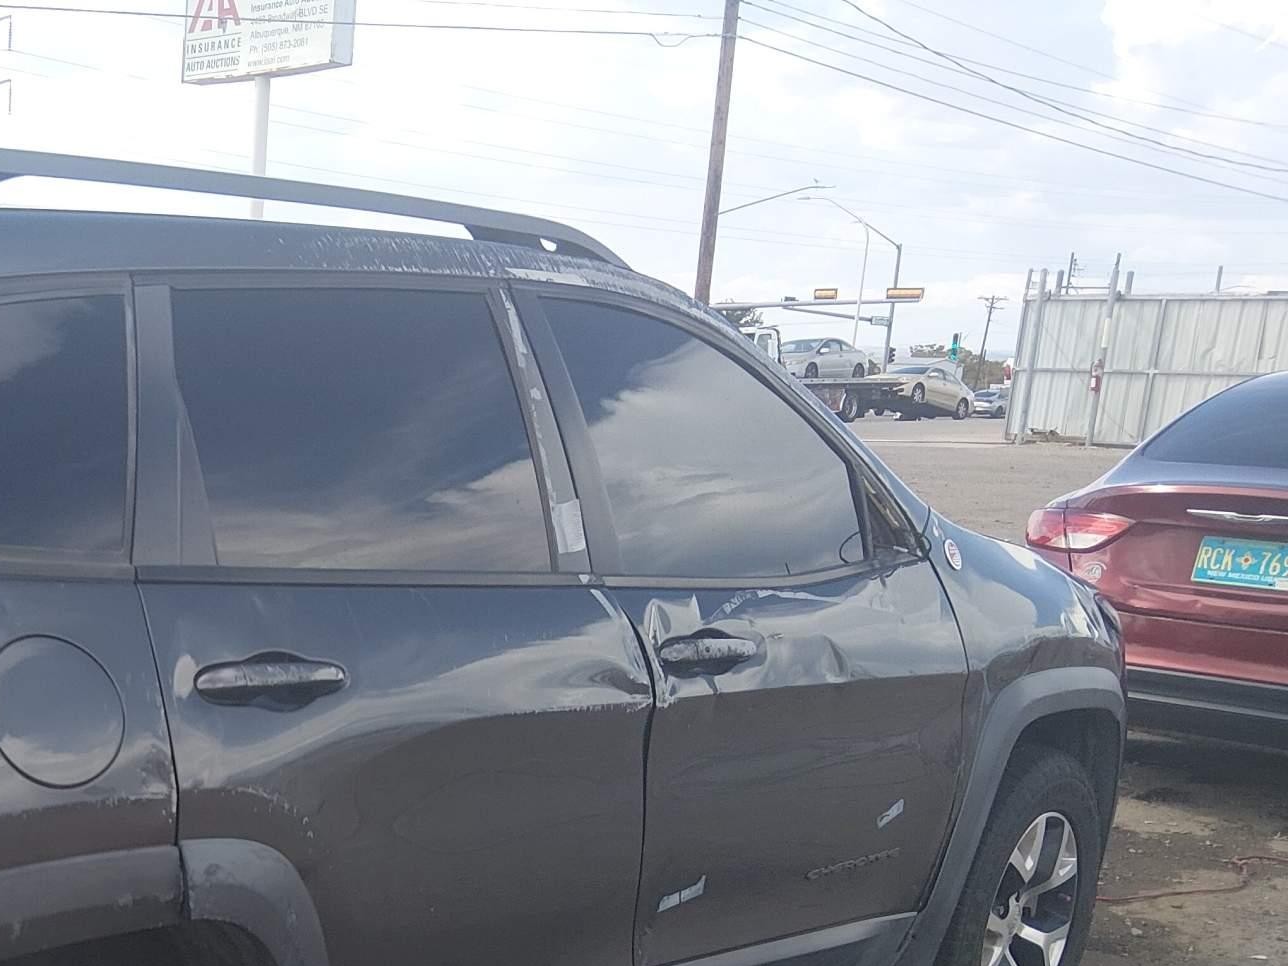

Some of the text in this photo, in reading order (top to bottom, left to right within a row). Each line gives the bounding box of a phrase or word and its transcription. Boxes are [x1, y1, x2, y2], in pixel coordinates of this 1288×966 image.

[186, 37, 242, 55] INSURANCE
[186, 55, 241, 72] AUTO AUCTIONS
[1198, 546, 1235, 571] RCK
